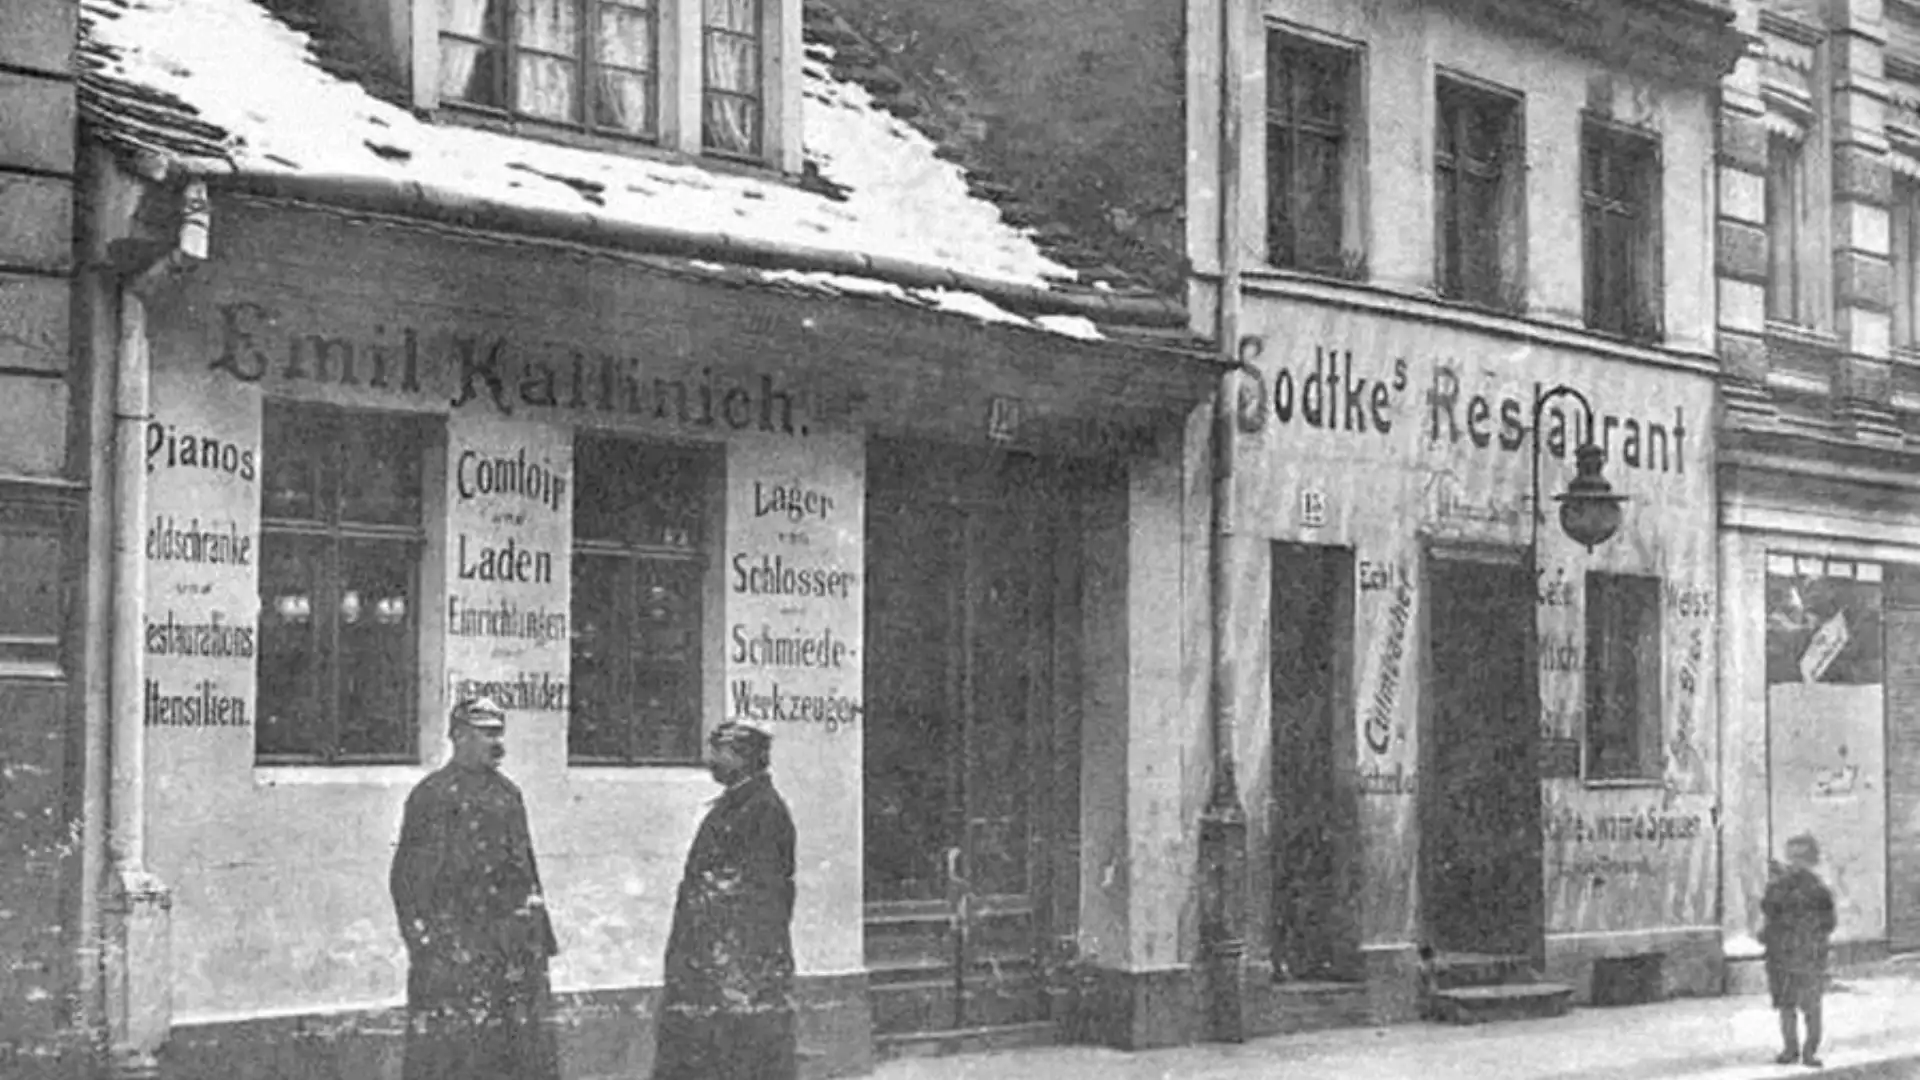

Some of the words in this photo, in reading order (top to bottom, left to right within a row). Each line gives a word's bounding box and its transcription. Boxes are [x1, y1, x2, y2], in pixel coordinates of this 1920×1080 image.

[209, 303, 420, 393] Emil
[1427, 362, 1687, 473] Resaurant
[146, 421, 255, 483] Pianos
[457, 446, 566, 512] Comtoir
[754, 480, 834, 523] Lager
[459, 533, 552, 584] Laden
[145, 608, 254, 658] estaurations
